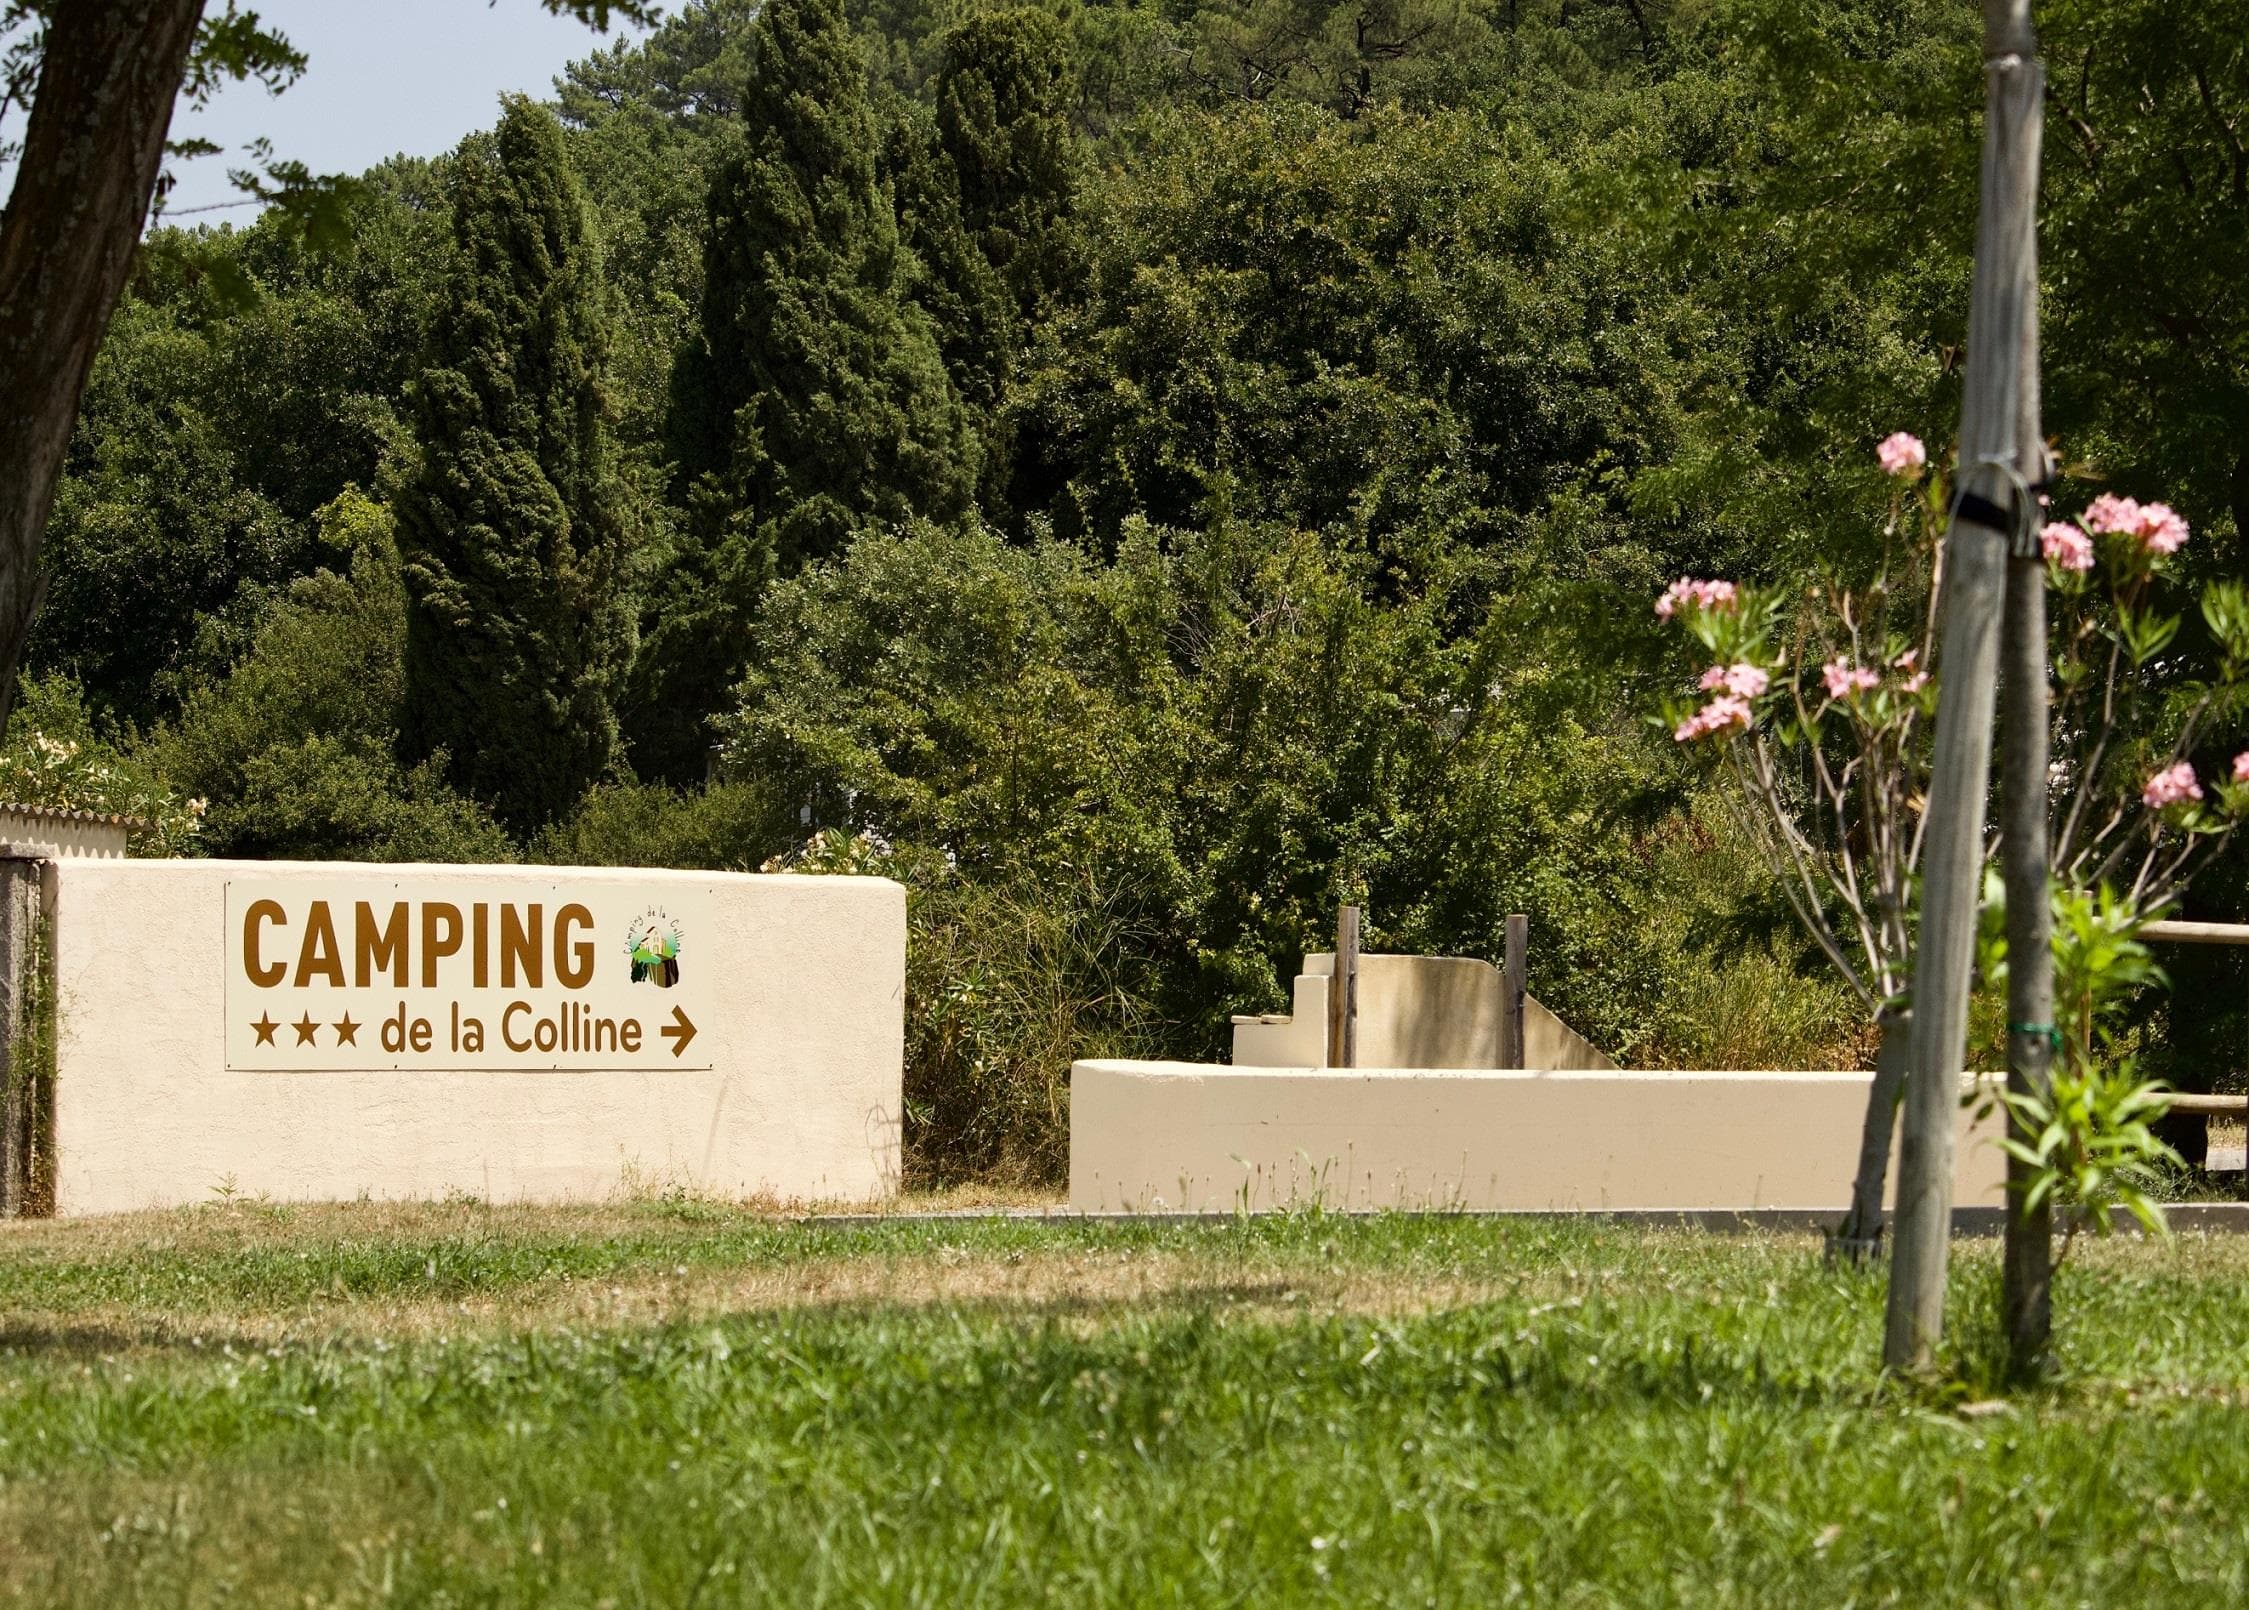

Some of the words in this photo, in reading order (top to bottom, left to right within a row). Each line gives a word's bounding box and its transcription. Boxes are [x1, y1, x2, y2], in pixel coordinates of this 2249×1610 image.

[647, 905, 656, 917] de
[659, 905, 667, 919] la
[243, 899, 595, 989] CAMPING
[380, 1000, 433, 1053] de
[451, 1000, 484, 1053] la
[501, 1001, 642, 1053] Colline
